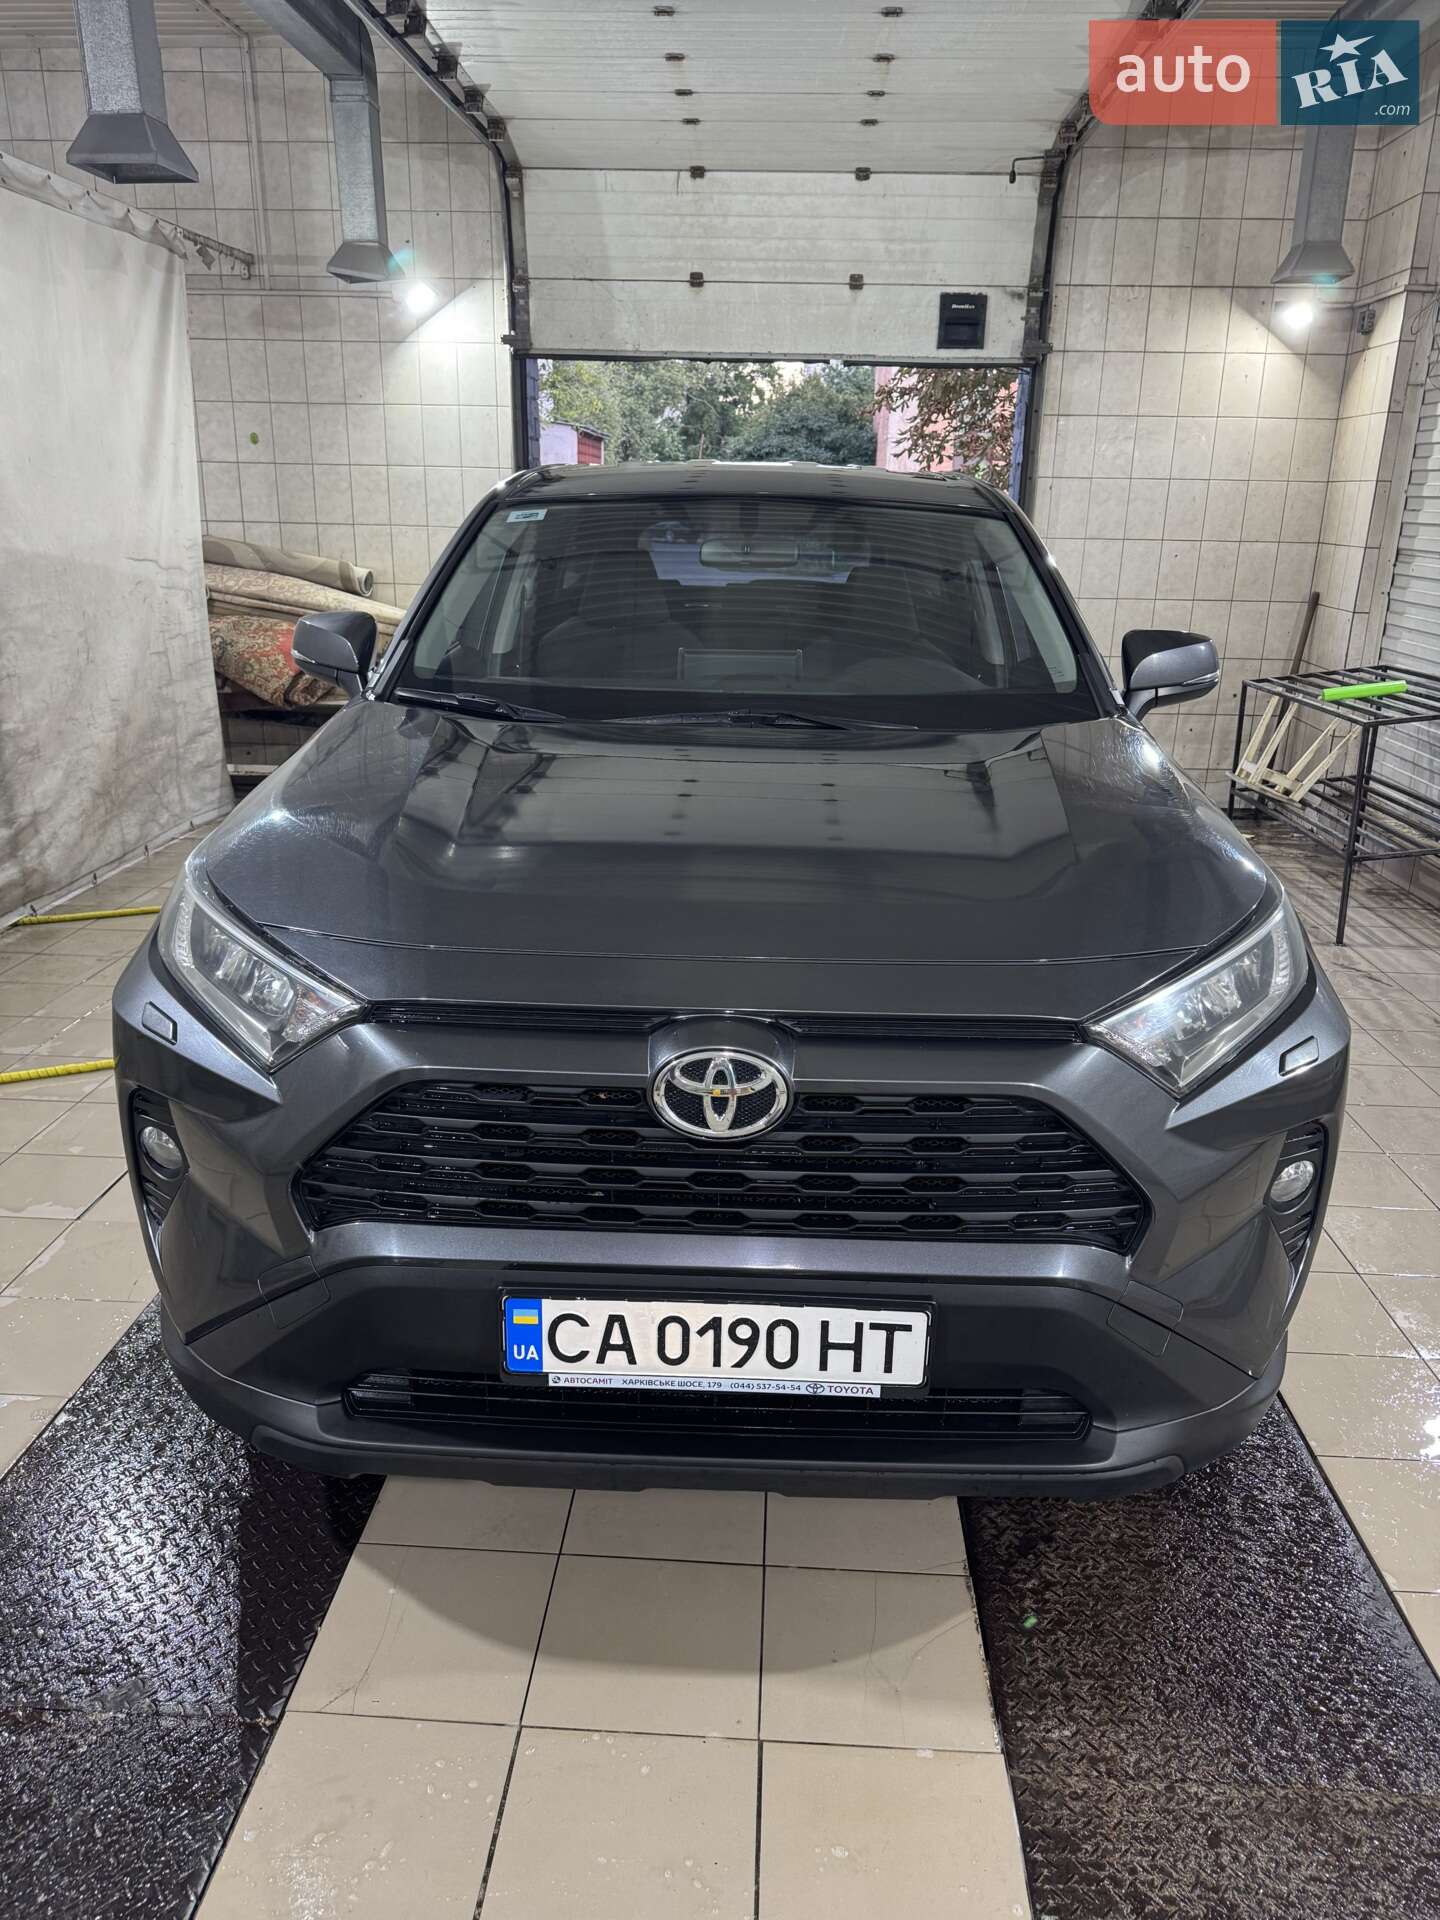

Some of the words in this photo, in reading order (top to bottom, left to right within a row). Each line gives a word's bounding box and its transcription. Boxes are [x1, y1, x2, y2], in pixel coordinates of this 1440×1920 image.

[547, 1312, 638, 1366] CA
[656, 1315, 800, 1370] 0190
[819, 1319, 913, 1374] HT
[513, 1344, 539, 1360] UA
[563, 1377, 614, 1385] АВТОСАМІТ
[621, 1378, 675, 1387] ХАРКІВСЬКЕ
[707, 1381, 722, 1389] 179
[827, 1385, 874, 1395] TOYOTA
